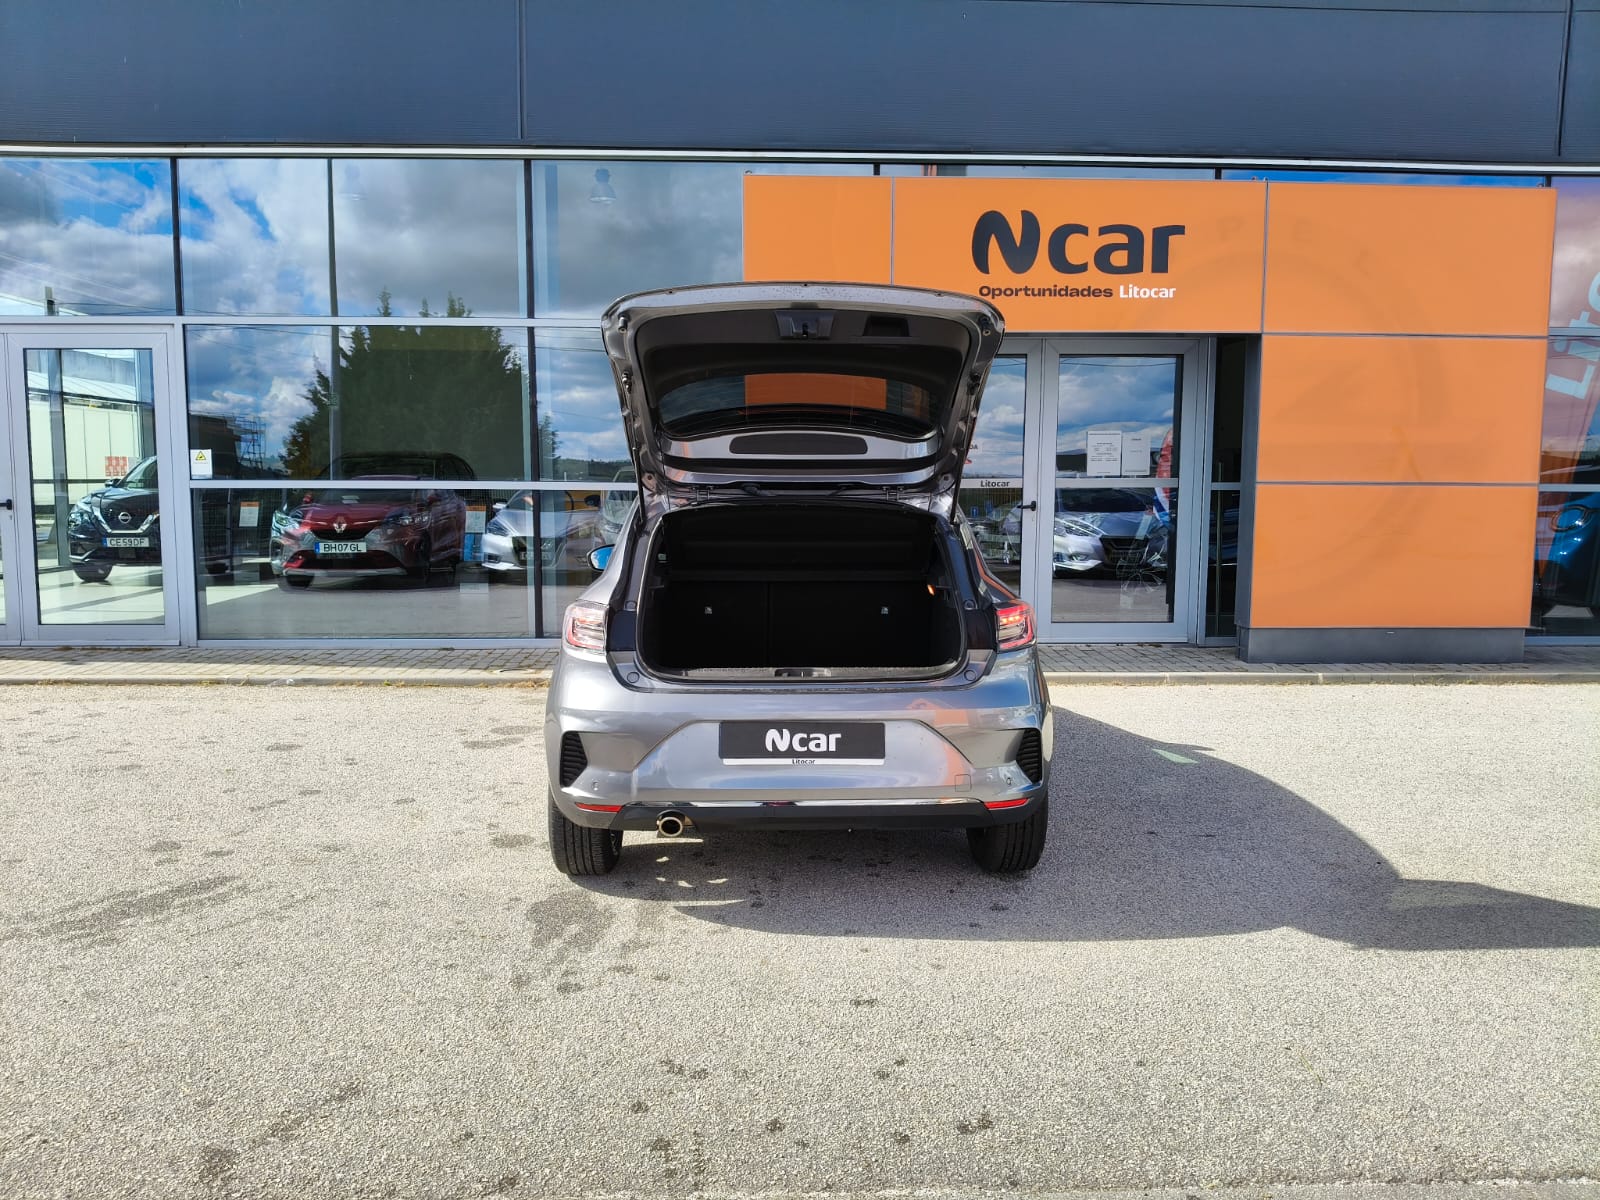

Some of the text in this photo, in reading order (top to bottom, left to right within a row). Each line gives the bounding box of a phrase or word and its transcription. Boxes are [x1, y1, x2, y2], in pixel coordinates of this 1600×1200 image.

[972, 209, 1186, 275] Ncar
[978, 284, 1176, 299] Oportunidades Litocar
[980, 479, 1010, 488] Litocar
[765, 728, 842, 752] Ncar
